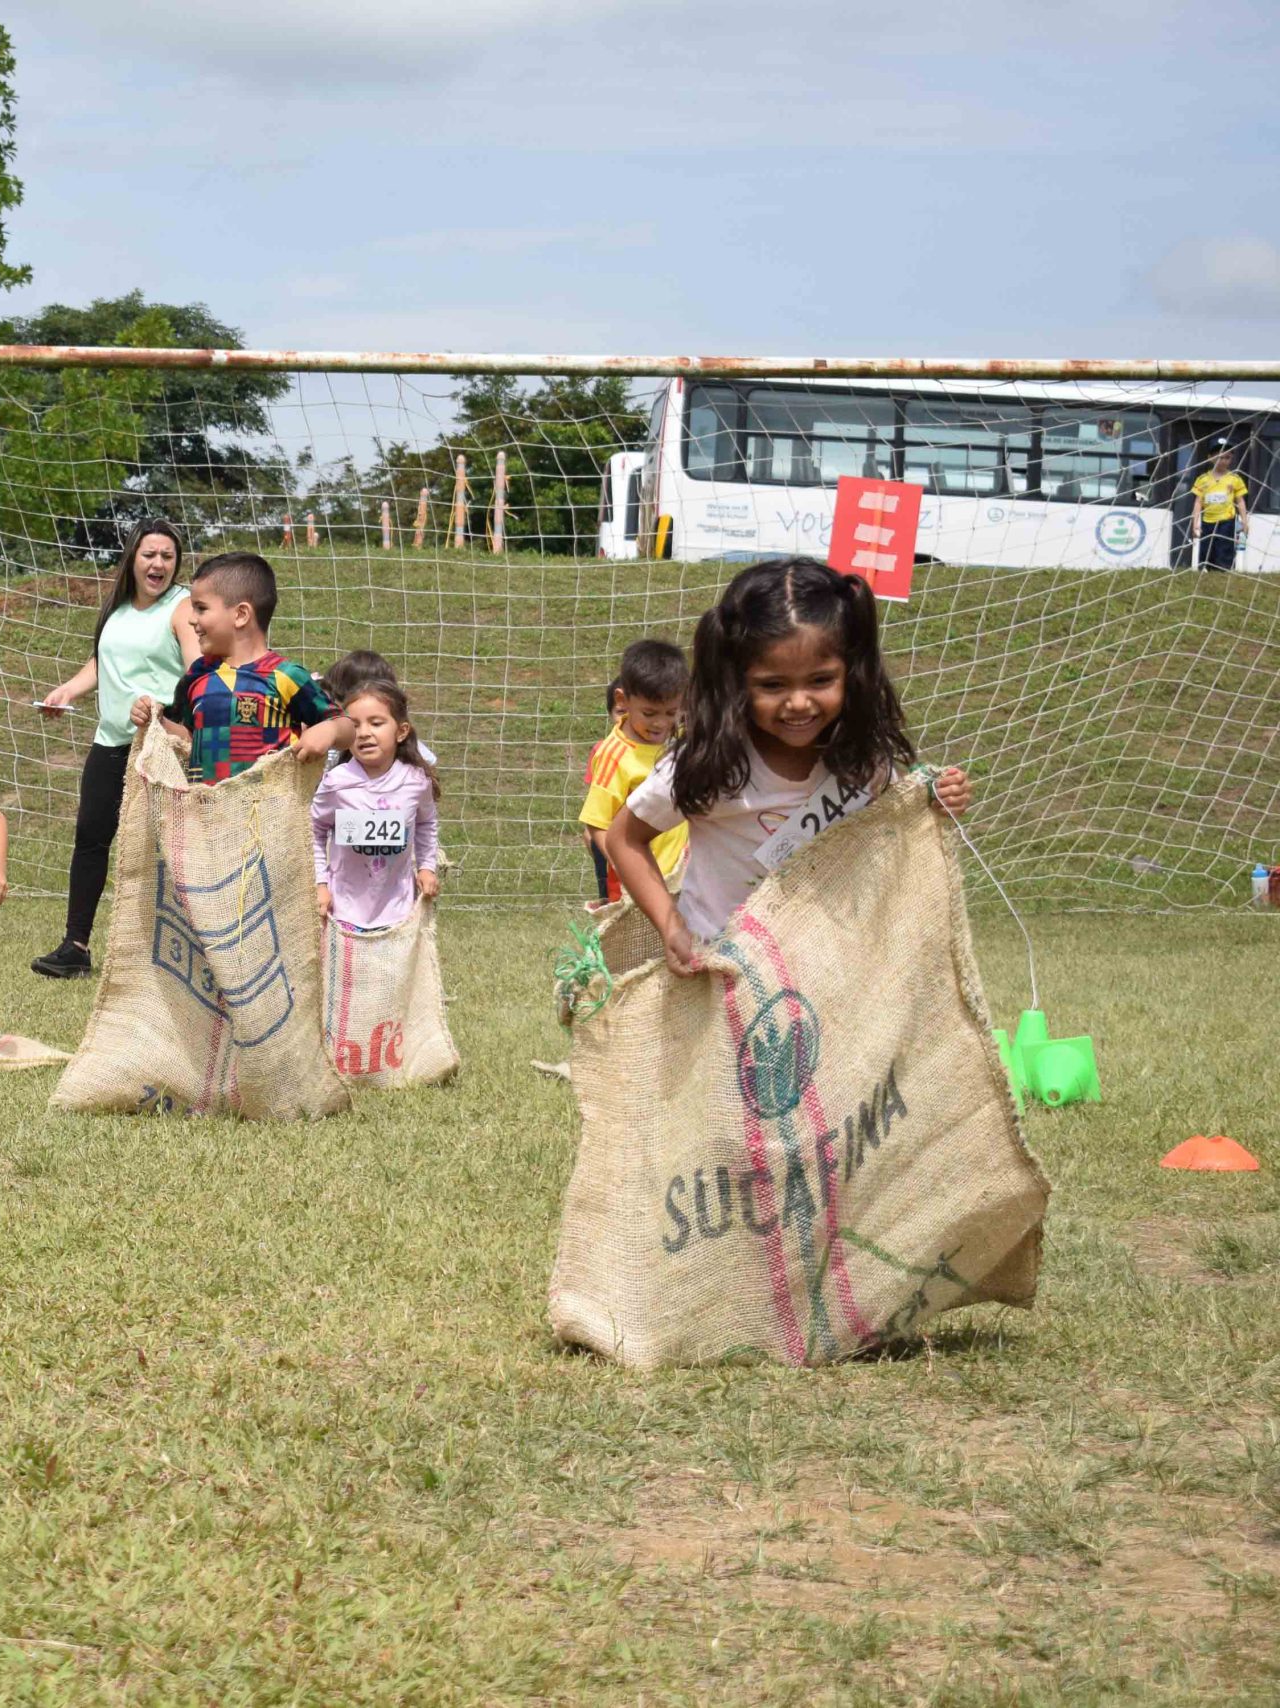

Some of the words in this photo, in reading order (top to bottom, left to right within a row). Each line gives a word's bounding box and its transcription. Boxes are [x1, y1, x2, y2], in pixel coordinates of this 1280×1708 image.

[364, 820, 402, 841] 242
[170, 938, 182, 963] 3
[328, 1020, 404, 1075] afé
[662, 1063, 908, 1254] SUCAFINA
